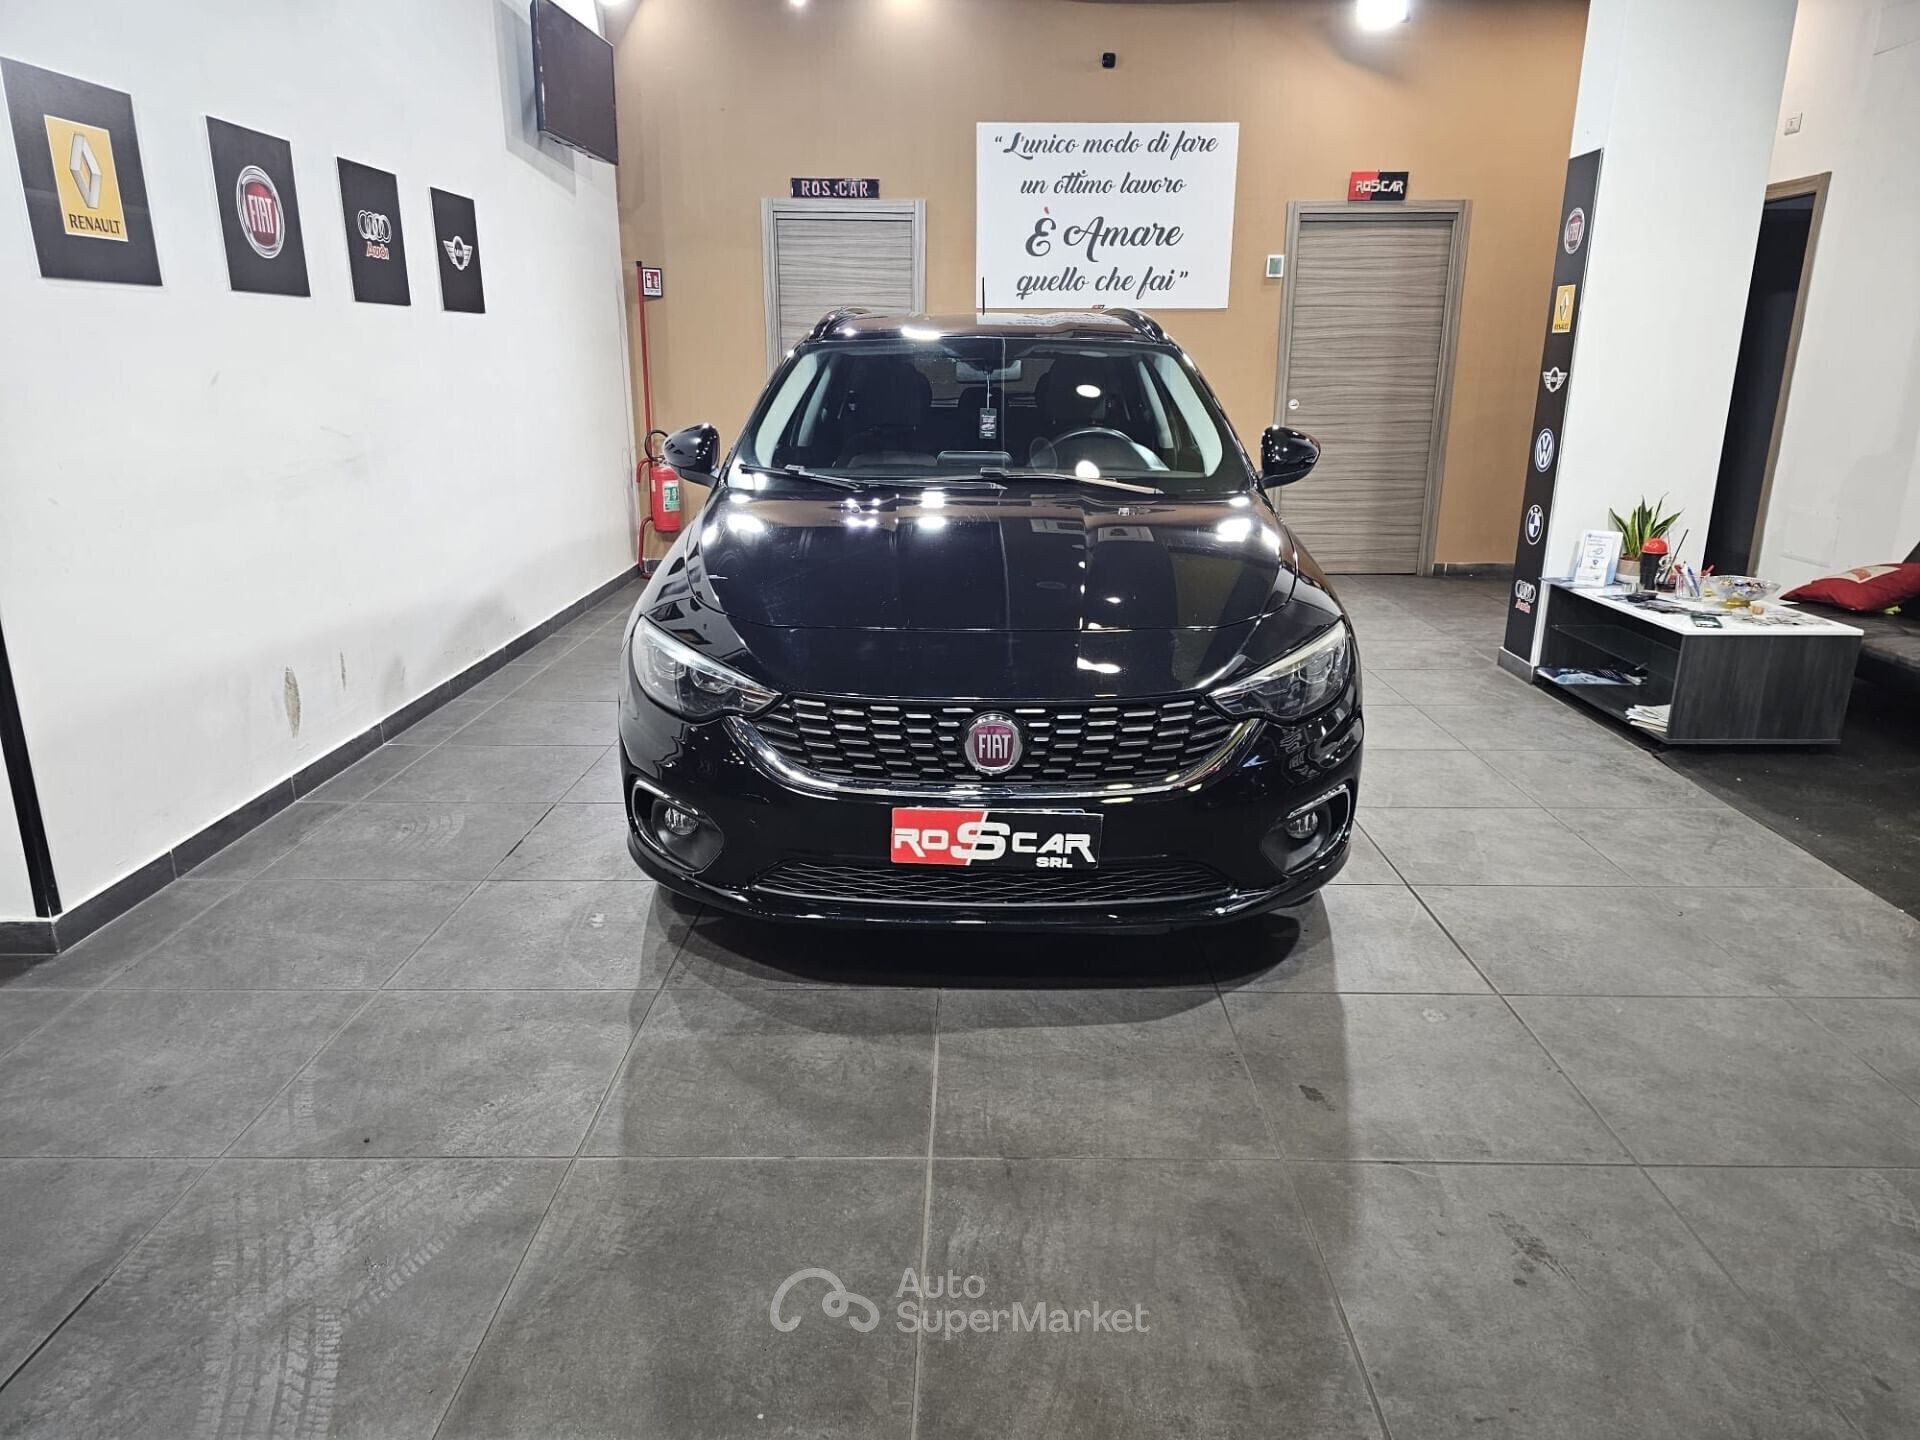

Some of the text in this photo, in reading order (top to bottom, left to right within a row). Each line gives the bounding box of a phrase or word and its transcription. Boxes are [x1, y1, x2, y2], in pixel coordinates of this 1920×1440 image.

[1082, 130, 1143, 154] modo
[1147, 130, 1170, 153] di
[1170, 130, 1218, 161] fare
[1020, 169, 1187, 194] un ottimo lavoro
[68, 213, 120, 234] RENAULT
[247, 194, 274, 234] FIAT
[1063, 216, 1184, 262] Amare
[1016, 266, 1090, 300] quello
[1094, 266, 1136, 291] che
[978, 734, 1011, 759] FIAT
[1036, 857, 1073, 868] SRL
